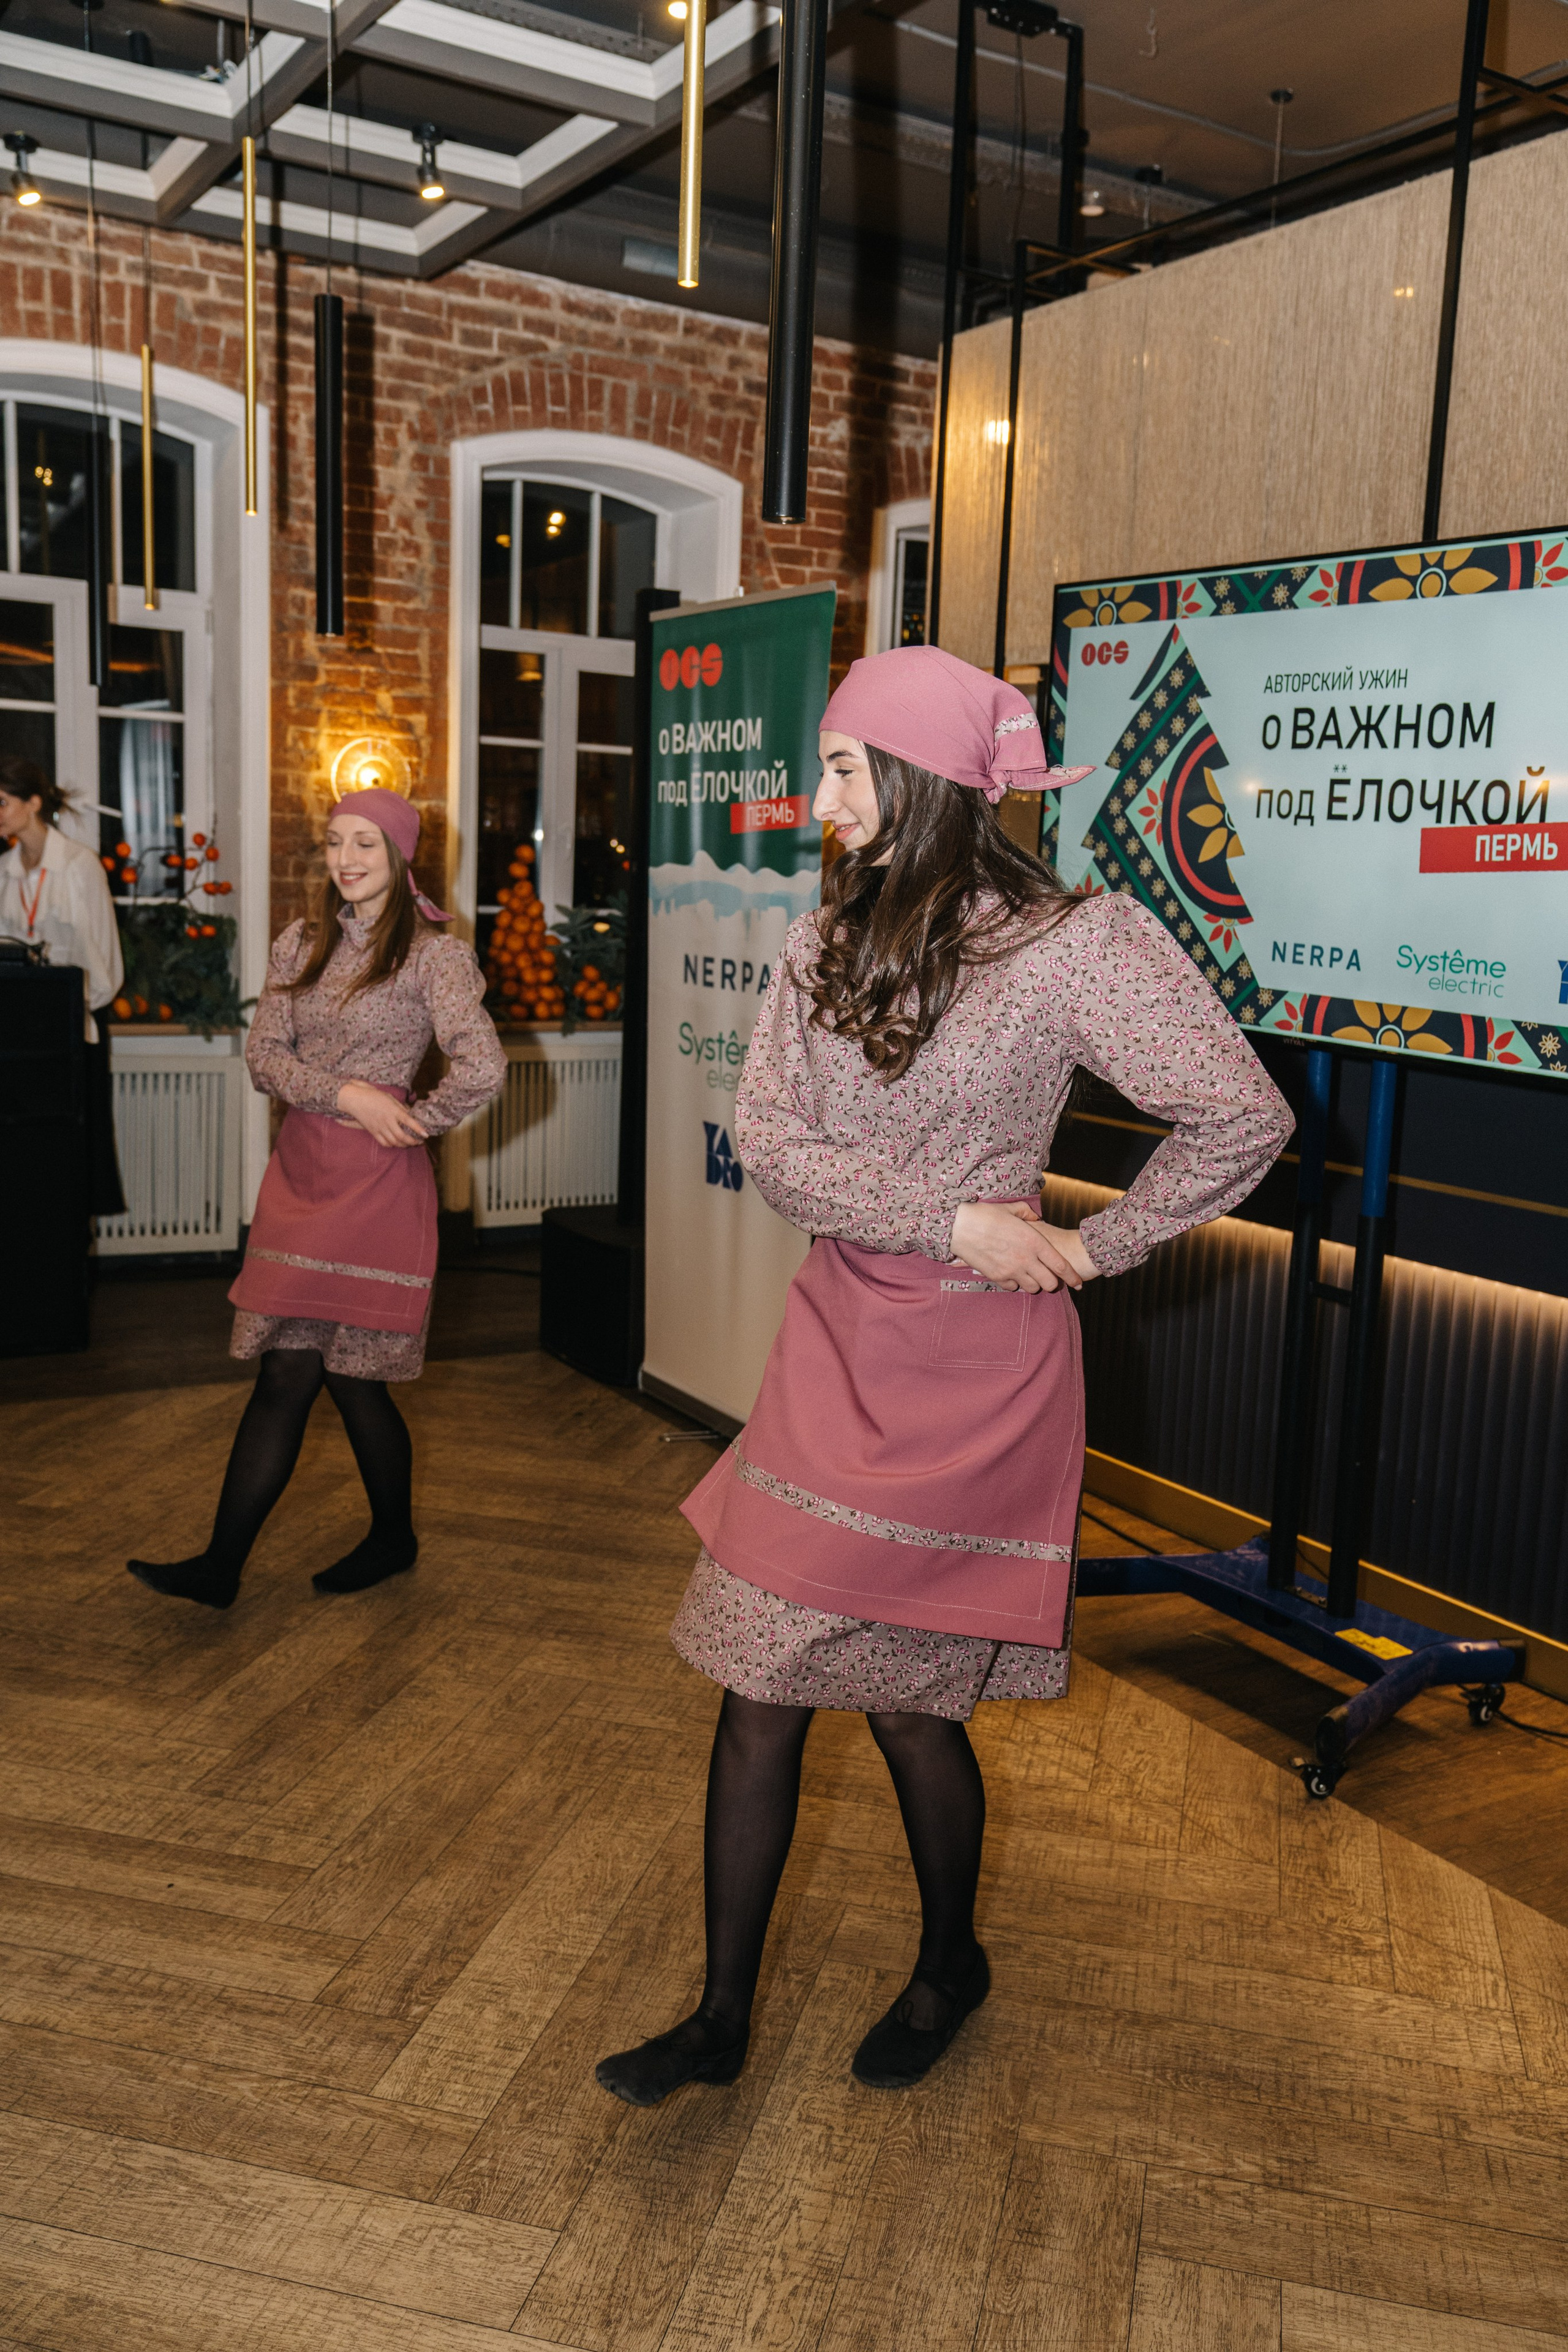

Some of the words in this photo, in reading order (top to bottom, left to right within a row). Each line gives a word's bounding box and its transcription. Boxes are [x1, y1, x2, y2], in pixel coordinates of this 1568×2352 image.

[659, 643, 723, 691] OCS
[1081, 641, 1129, 666] OCS
[1264, 666, 1353, 693] АВТОРСКИЙ
[1359, 668, 1408, 690] УЖИН
[672, 717, 763, 754] ВАЖНОМ
[1291, 701, 1496, 749] ВАЖНОМ
[658, 780, 688, 807] под
[1256, 789, 1314, 826] под
[1327, 764, 1551, 825] ЁЛОЧКОЙ
[746, 802, 795, 827] ПЕРМЬ
[1475, 832, 1558, 862] ПЕРМЬ
[1272, 941, 1361, 971] NERPA
[1396, 944, 1507, 978] Systême
[684, 953, 771, 995] NERPA
[1428, 973, 1505, 998] electric
